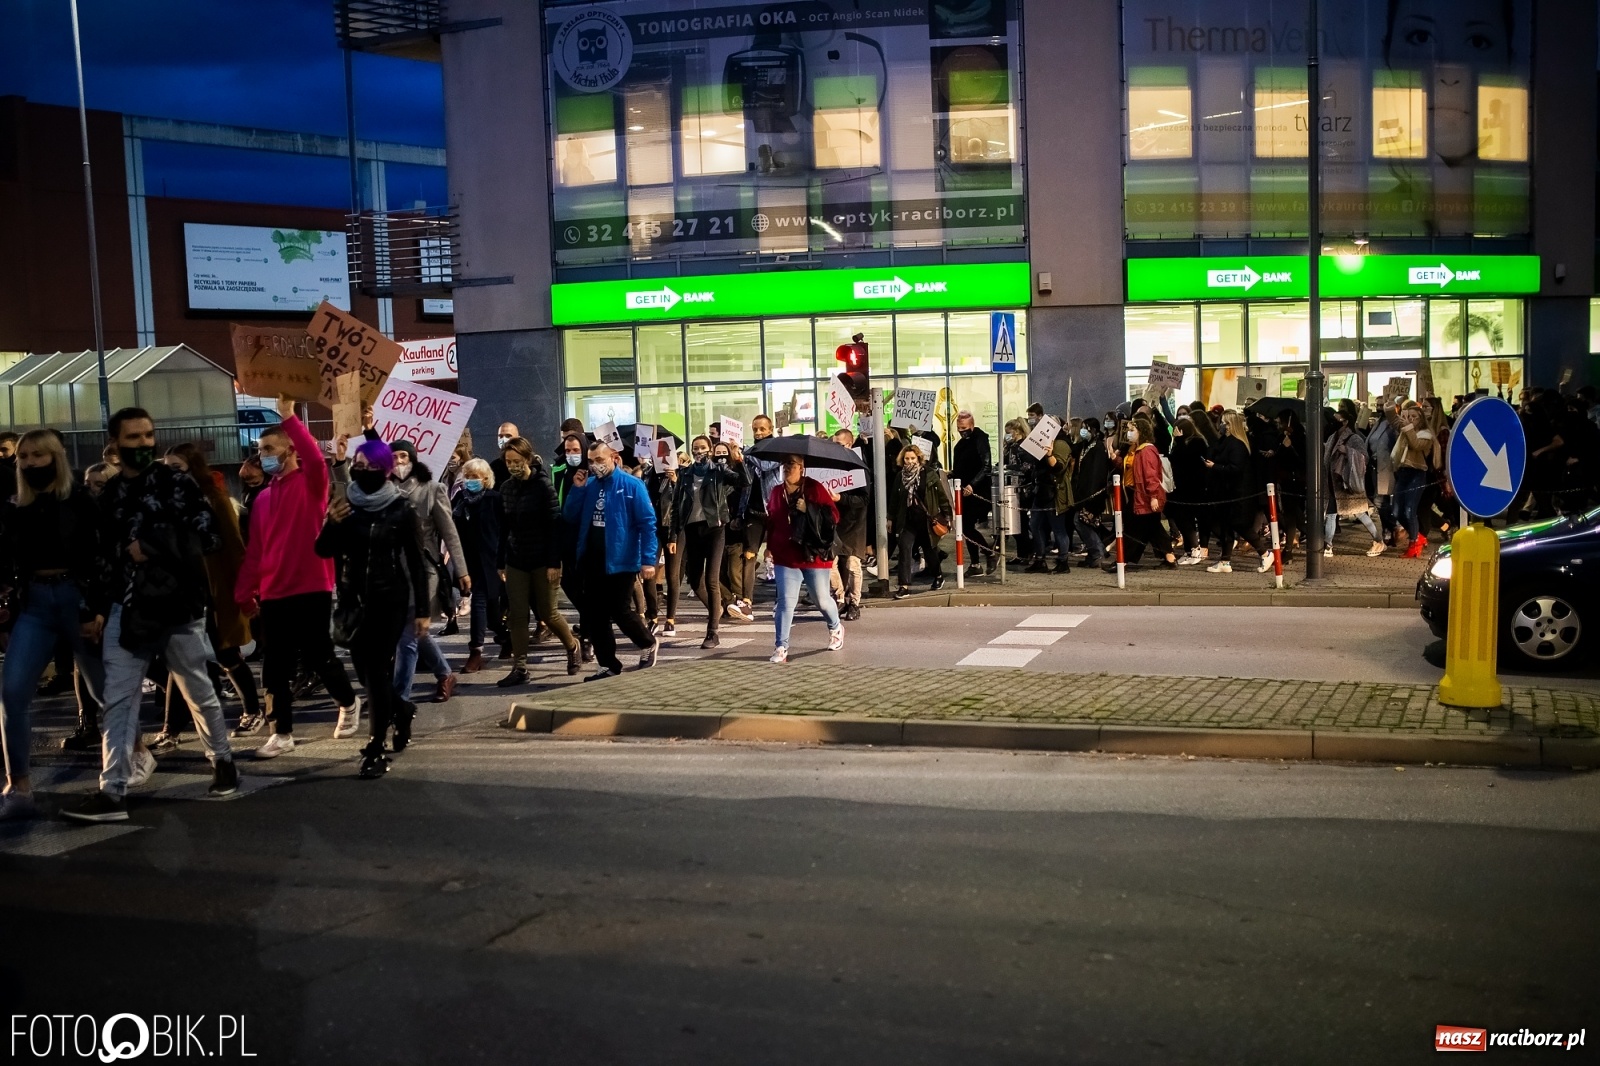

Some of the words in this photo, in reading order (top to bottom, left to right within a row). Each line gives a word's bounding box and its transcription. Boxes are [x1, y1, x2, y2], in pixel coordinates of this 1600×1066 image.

[561, 13, 585, 37] ZAKŁAD
[587, 11, 624, 31] OPTYCZNY
[638, 12, 753, 35] TOMOGRAFIA
[759, 10, 797, 25] OKA
[809, 13, 829, 22] OCT
[865, 10, 890, 19] Scan
[894, 8, 925, 17] Nidek
[1144, 15, 1328, 53] ThermaVen
[1255, 123, 1288, 132] metoda
[1149, 202, 1165, 213] 32
[1170, 202, 1194, 213] 415
[1200, 201, 1215, 212] 23
[1220, 201, 1236, 212] 39
[1256, 200, 1398, 214] www.faykaurody.eu
[587, 224, 612, 242] 32
[622, 220, 661, 240] 415
[672, 218, 698, 237] 27
[709, 216, 734, 234] 21
[775, 203, 1014, 228] www.optyk-raciborz.pl
[1262, 272, 1292, 283] BANK
[1455, 270, 1480, 281] BANK
[915, 282, 947, 293] BANK
[683, 291, 715, 303] BANK
[324, 311, 378, 355] TWÓJ
[403, 344, 444, 360] Kaufland
[315, 336, 348, 368] BÓL
[352, 358, 388, 386] JEST
[412, 366, 435, 376] parking
[896, 389, 915, 399] ŁAPY
[382, 389, 461, 425] OBRONIE
[896, 399, 907, 407] OD
[910, 399, 931, 411] MOJEJ
[895, 408, 923, 421] MACICY
